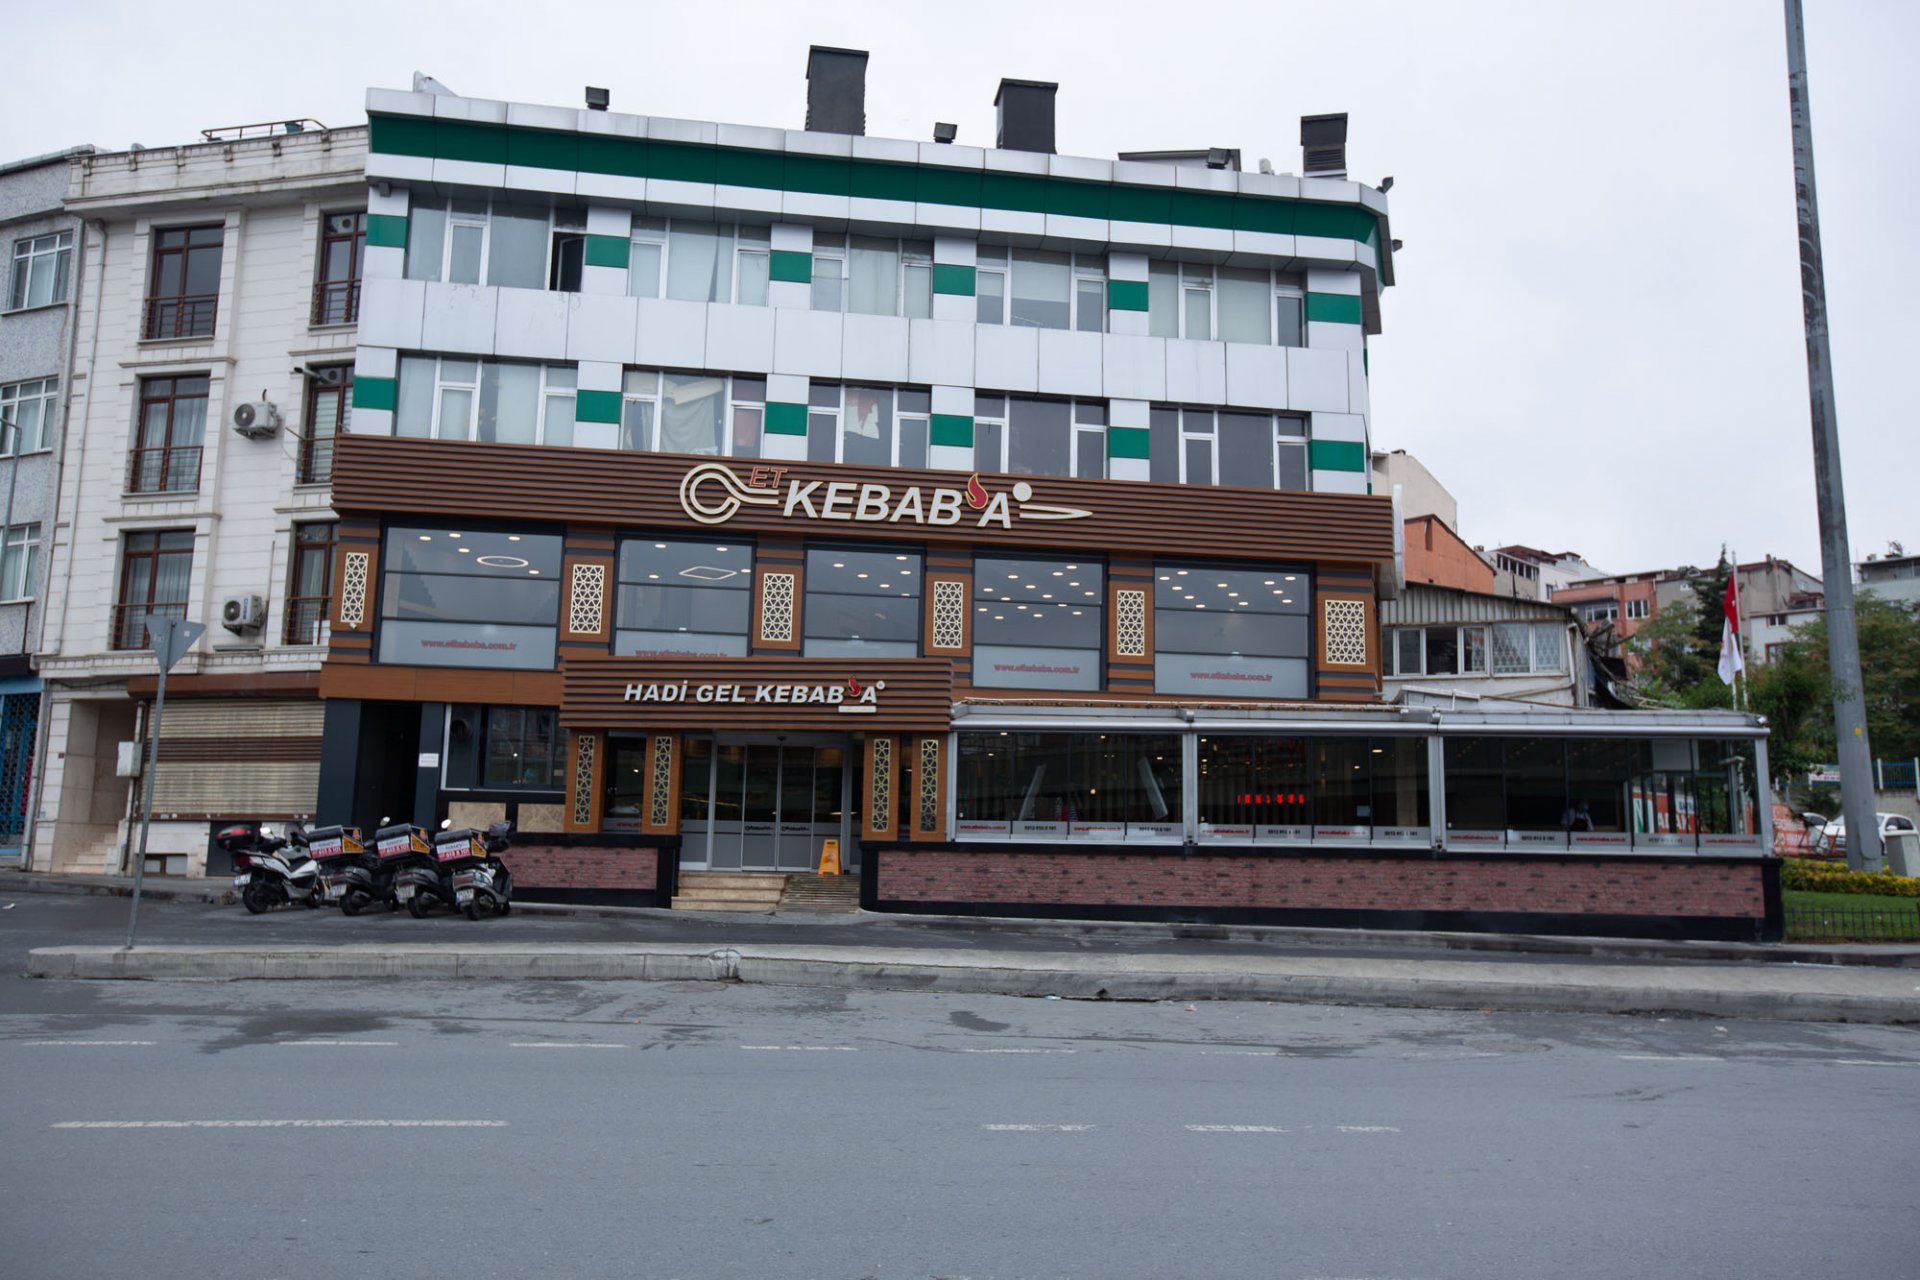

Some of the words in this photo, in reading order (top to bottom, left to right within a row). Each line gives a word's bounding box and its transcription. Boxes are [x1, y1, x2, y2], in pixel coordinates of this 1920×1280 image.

[748, 466, 788, 489] ET
[624, 679, 689, 703] HADİ
[695, 684, 747, 703] GEL
